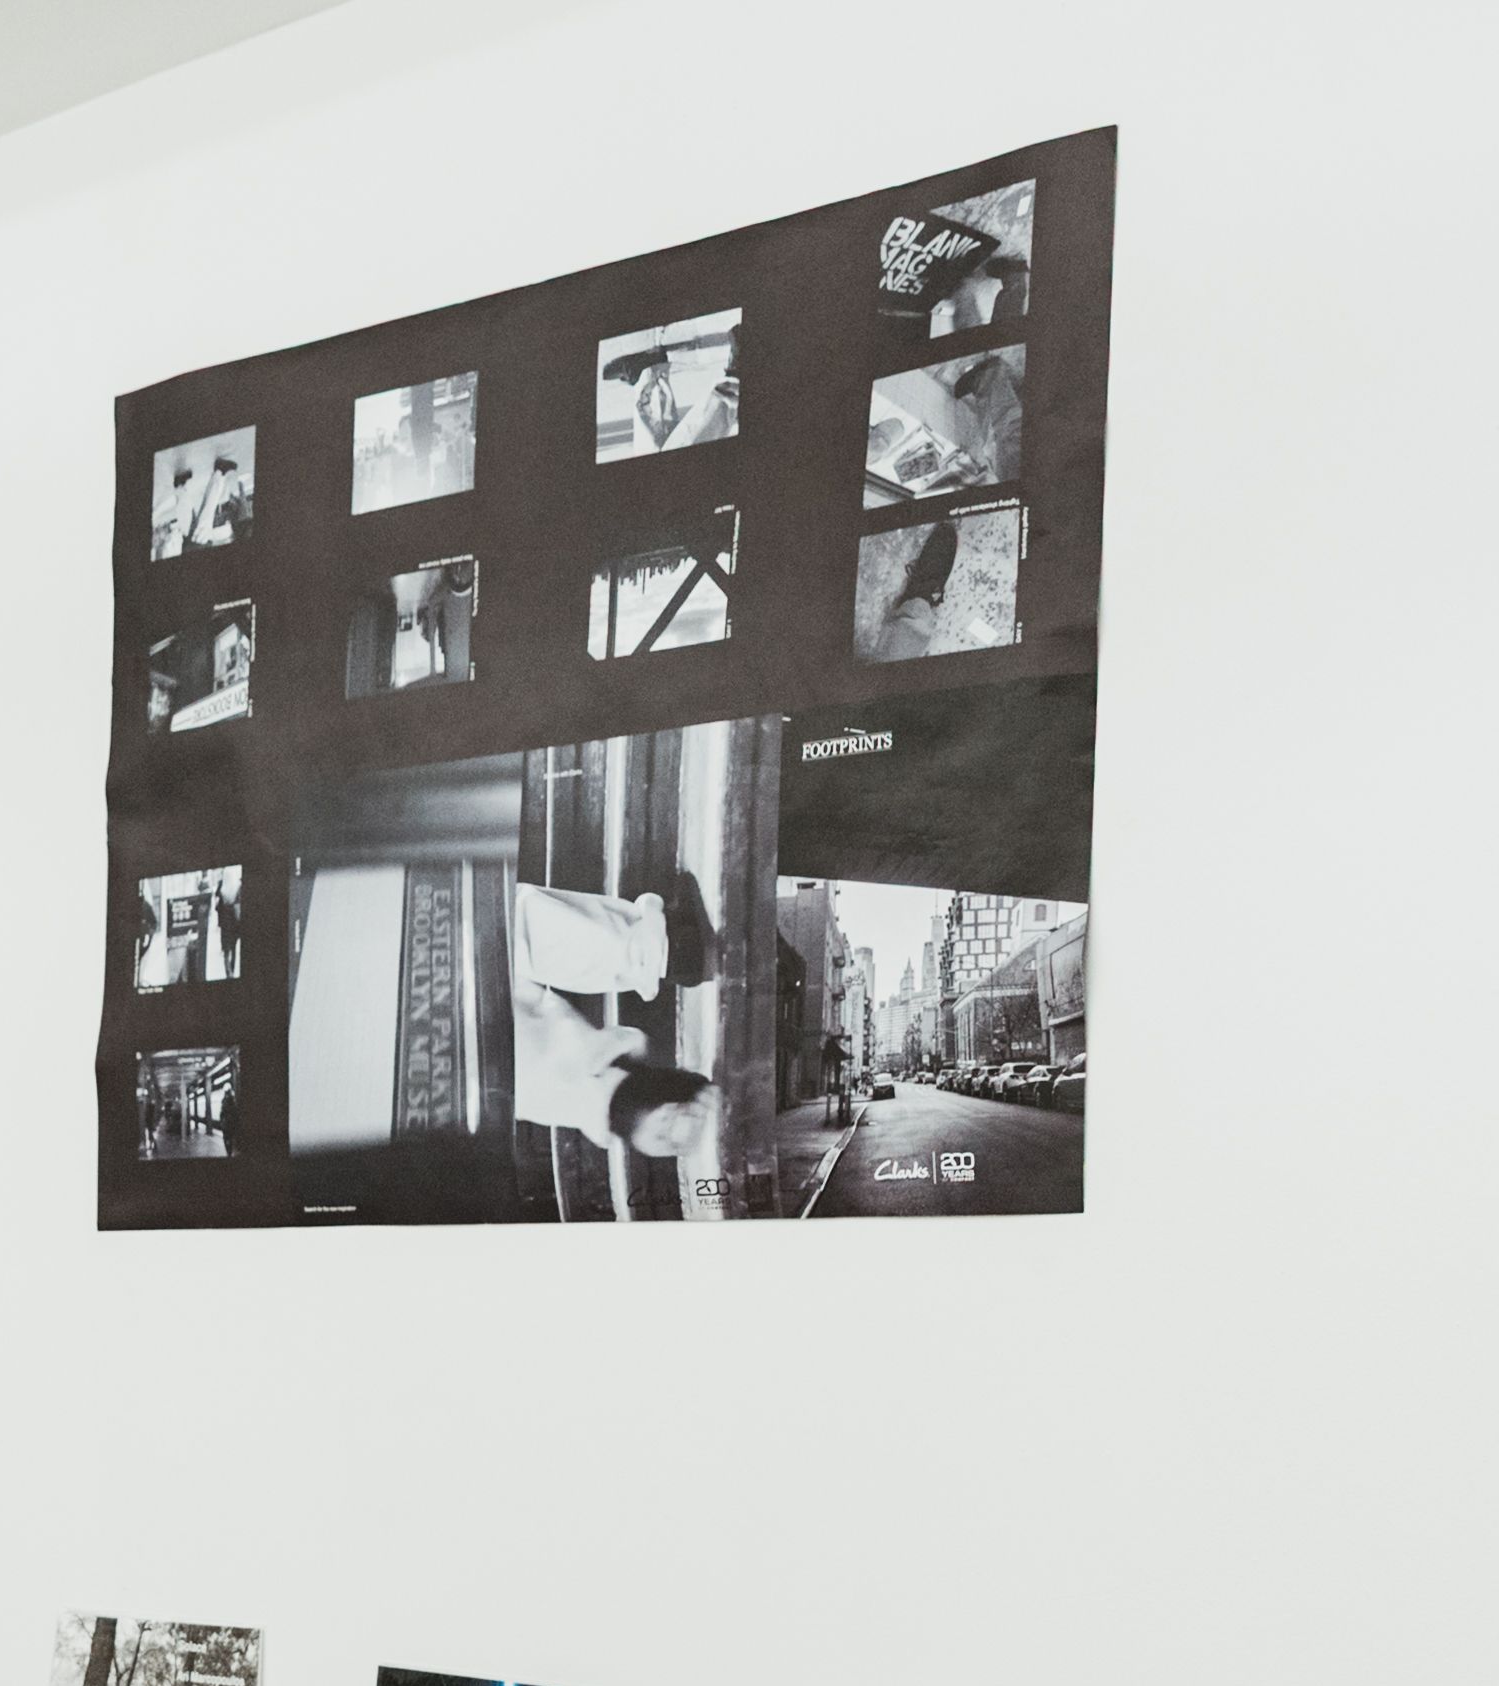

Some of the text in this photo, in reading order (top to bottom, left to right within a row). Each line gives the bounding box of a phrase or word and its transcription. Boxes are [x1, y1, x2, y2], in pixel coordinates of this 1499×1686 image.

[802, 732, 893, 761] FOOTPRINTS
[432, 889, 452, 1005] EASTERN
[874, 1160, 929, 1182] Clarks
[941, 1152, 975, 1170] 200
[941, 1169, 975, 1178] YEARS
[695, 1178, 731, 1197] 200
